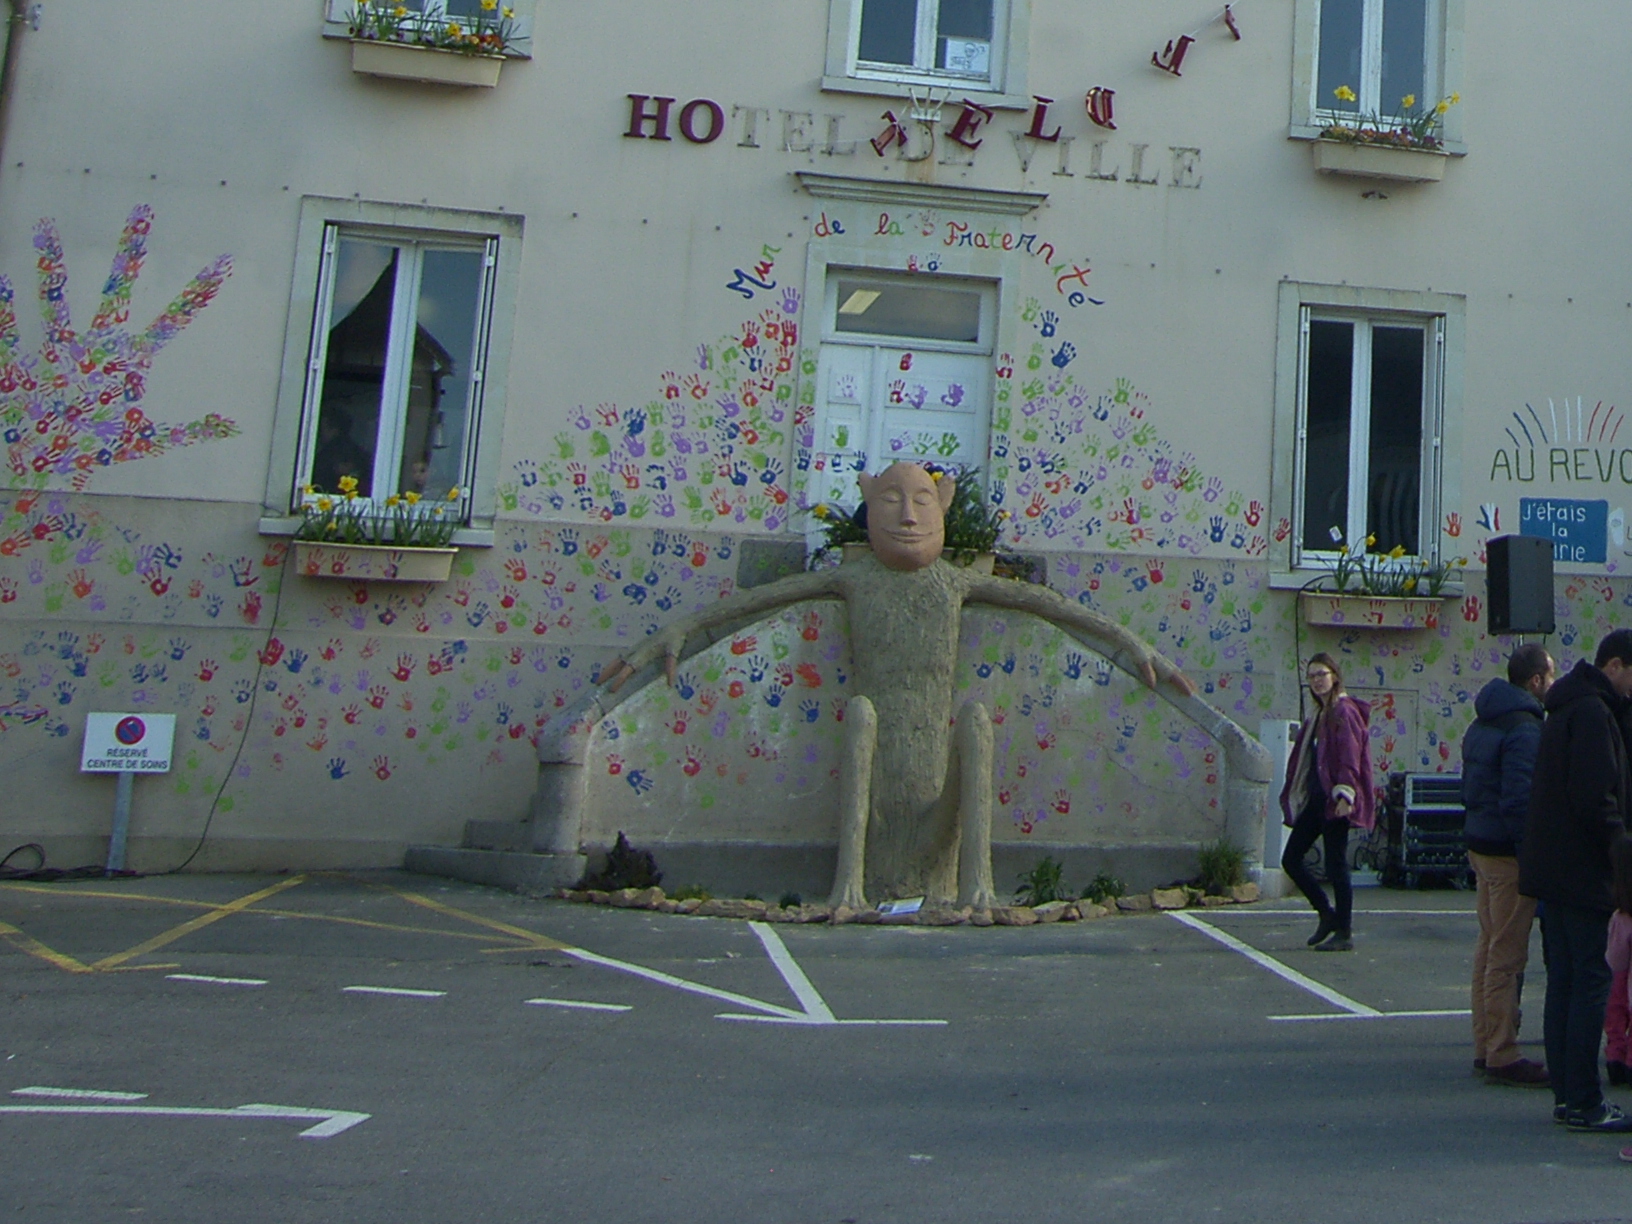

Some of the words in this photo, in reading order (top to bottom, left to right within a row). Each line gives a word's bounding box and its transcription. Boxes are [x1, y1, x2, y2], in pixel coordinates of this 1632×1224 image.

[623, 94, 858, 156] HOTEL
[1009, 128, 1203, 189] VILLE
[726, 242, 781, 299] Mur
[814, 212, 846, 238] de
[874, 212, 905, 236] la
[1490, 448, 1535, 482] AU
[1522, 501, 1588, 523] J'étais
[1552, 523, 1569, 538] la
[1553, 543, 1587, 562] irie
[86, 759, 123, 769] CENTRE
[125, 759, 137, 769] DE
[140, 760, 169, 770] SOINS
